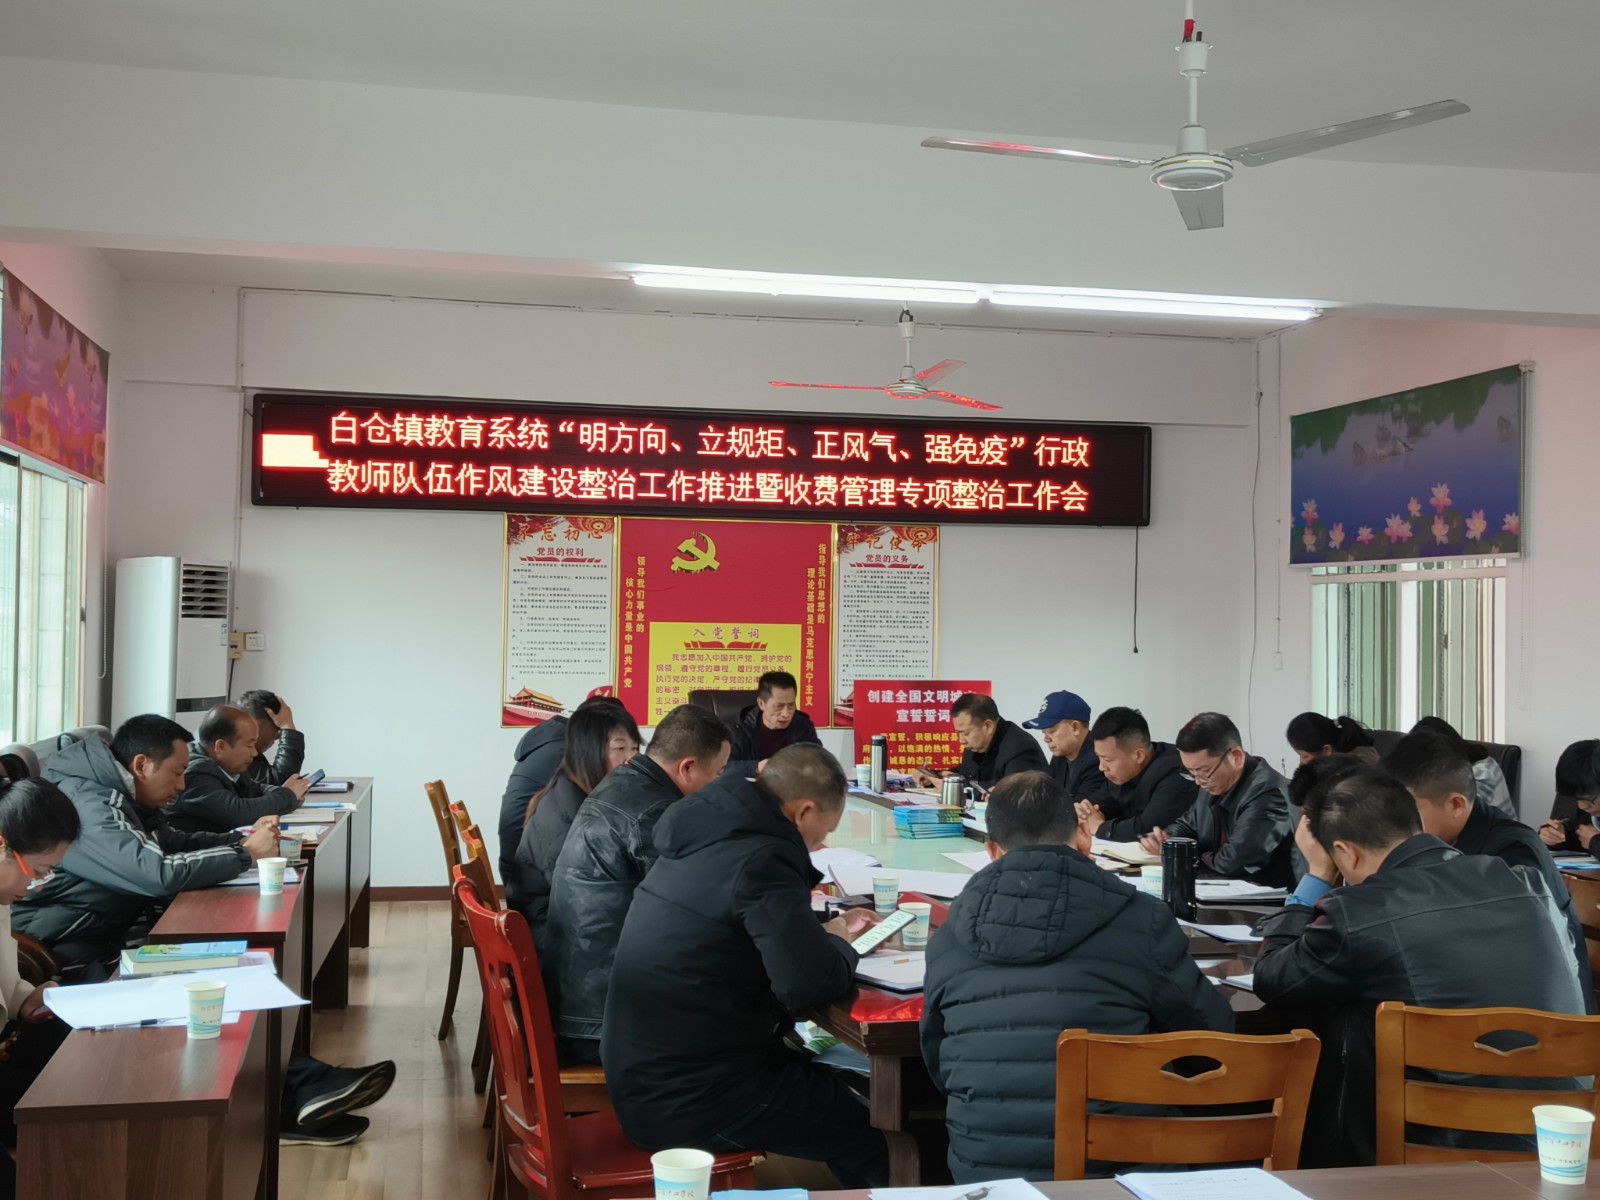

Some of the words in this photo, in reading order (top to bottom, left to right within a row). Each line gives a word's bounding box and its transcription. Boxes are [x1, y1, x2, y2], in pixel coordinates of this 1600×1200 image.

[330, 411, 1091, 468] 白仓镇教育系统“明方向、立规矩、正风气、强免疫”行政
[326, 459, 1090, 512] 教师队伍作风建设整治工作推进暨收费管理专项整治工作会
[517, 523, 605, 542] 不忘初心
[846, 531, 928, 553] 牢记使命
[536, 547, 584, 557] 党员的权利
[865, 554, 909, 563] 党员的义务
[636, 556, 646, 633] 领导我们事业的
[816, 543, 828, 624] 指导我们思想的
[623, 577, 635, 688] 核心力量是中国共产党
[692, 626, 761, 640] 入党誓词
[804, 567, 816, 706] 理论基础是马克思列宁主义
[896, 708, 951, 723] 宣誓誓词
